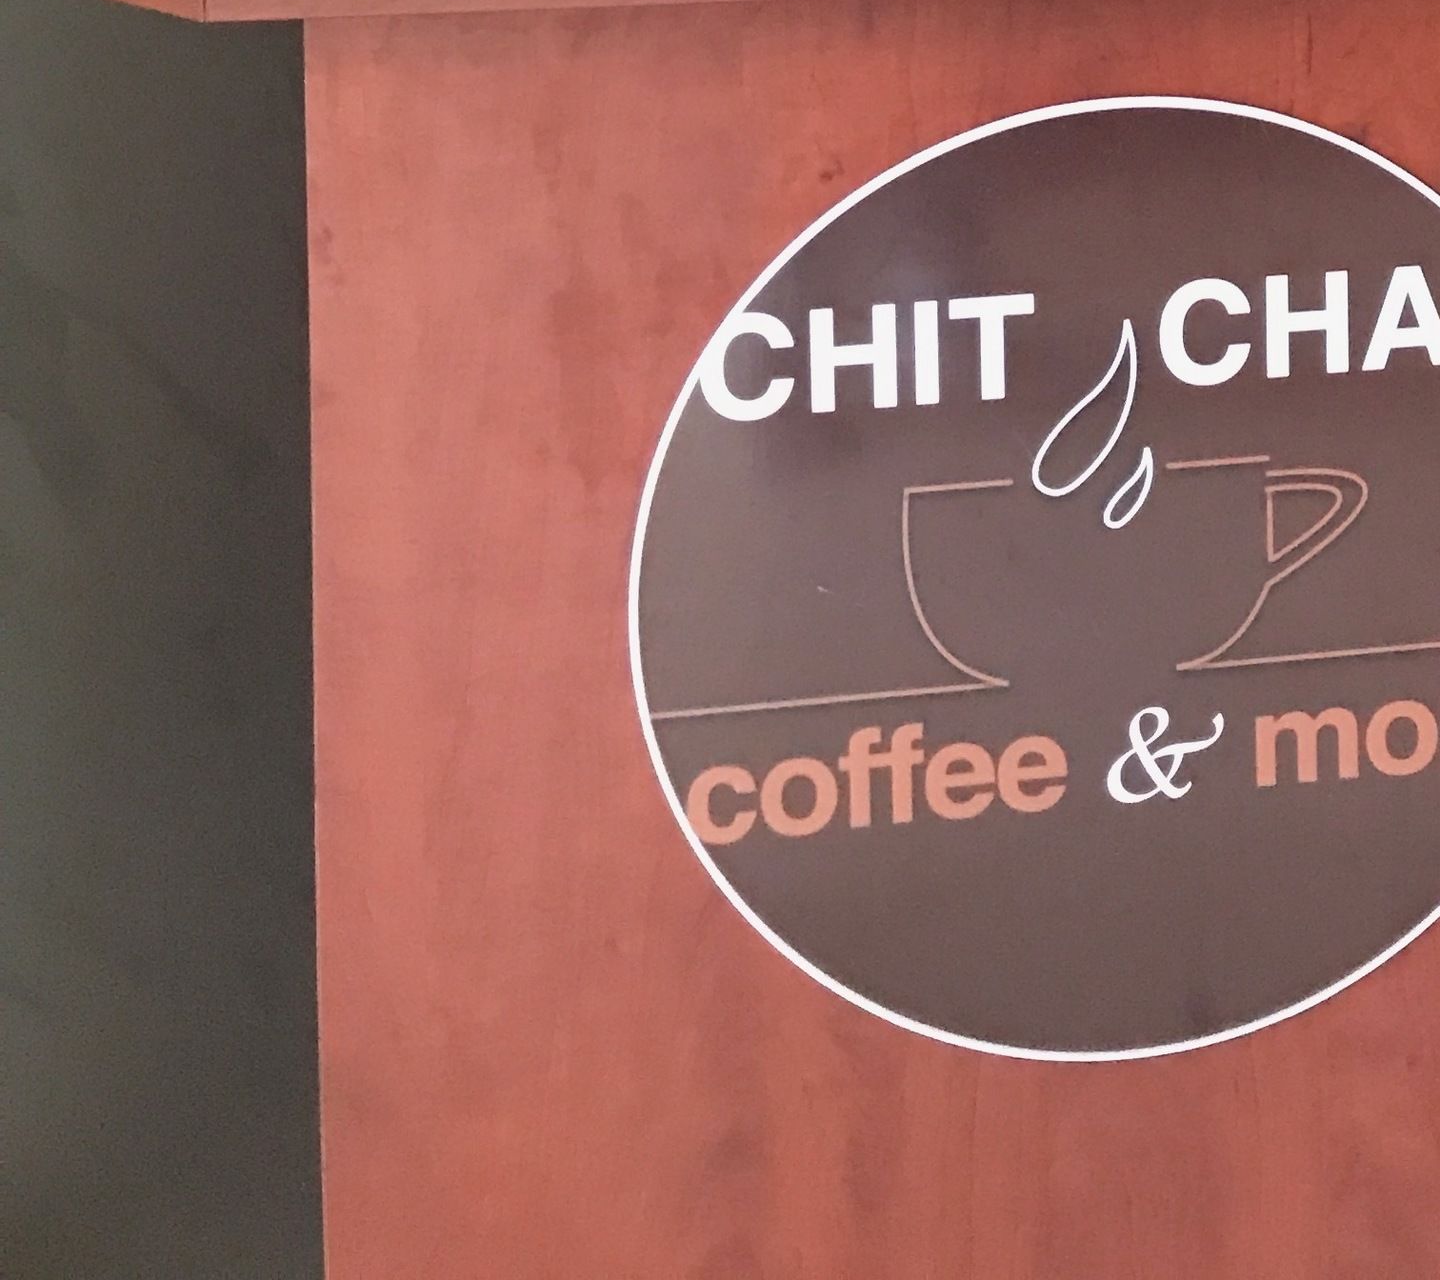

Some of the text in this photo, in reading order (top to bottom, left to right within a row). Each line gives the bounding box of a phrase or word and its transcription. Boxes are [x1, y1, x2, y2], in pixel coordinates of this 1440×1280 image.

[695, 290, 1036, 423] CHIT
[686, 723, 1069, 845] coffee
[1105, 705, 1225, 804] &
